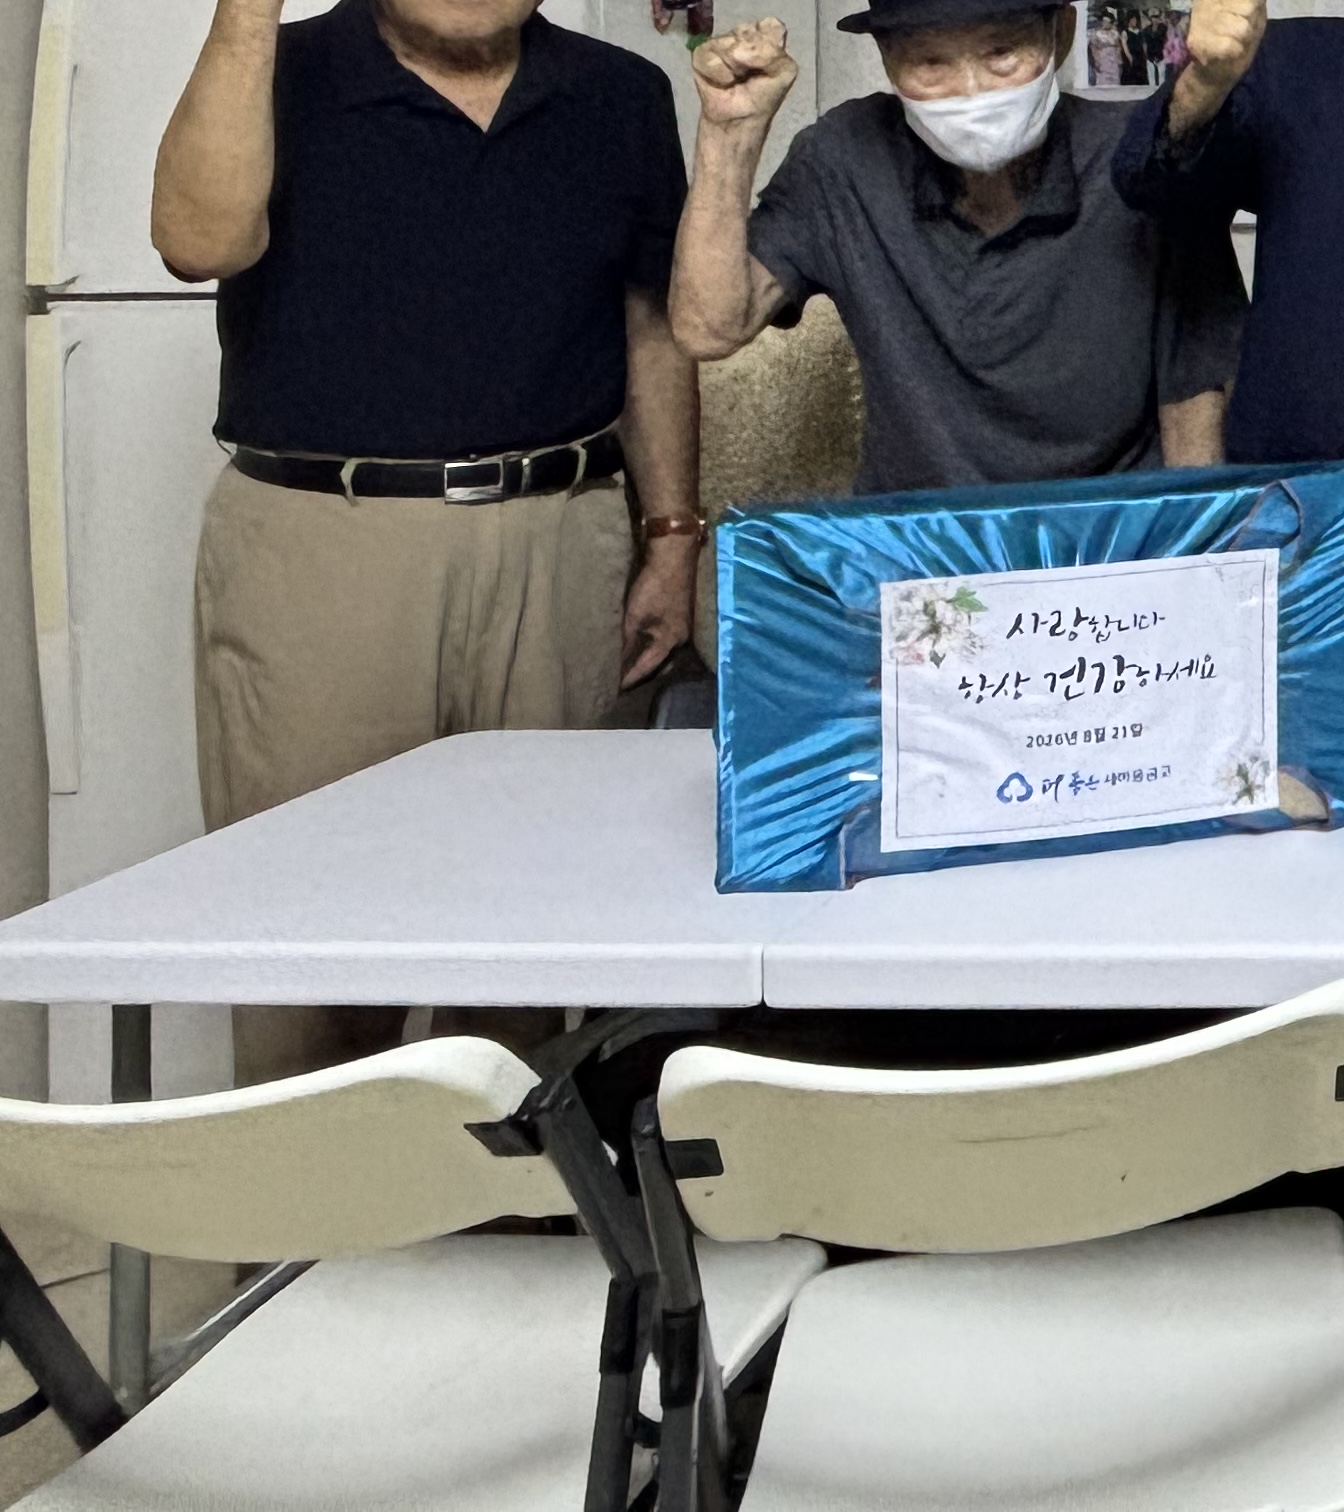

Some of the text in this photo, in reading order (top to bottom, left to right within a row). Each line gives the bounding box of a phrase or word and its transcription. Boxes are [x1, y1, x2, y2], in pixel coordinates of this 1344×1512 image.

[1006, 607, 1166, 643] 사랑합니다
[958, 654, 1218, 704] 항상 건강하세요
[1112, 723, 1143, 739] 21일
[1042, 774, 1065, 803] 더
